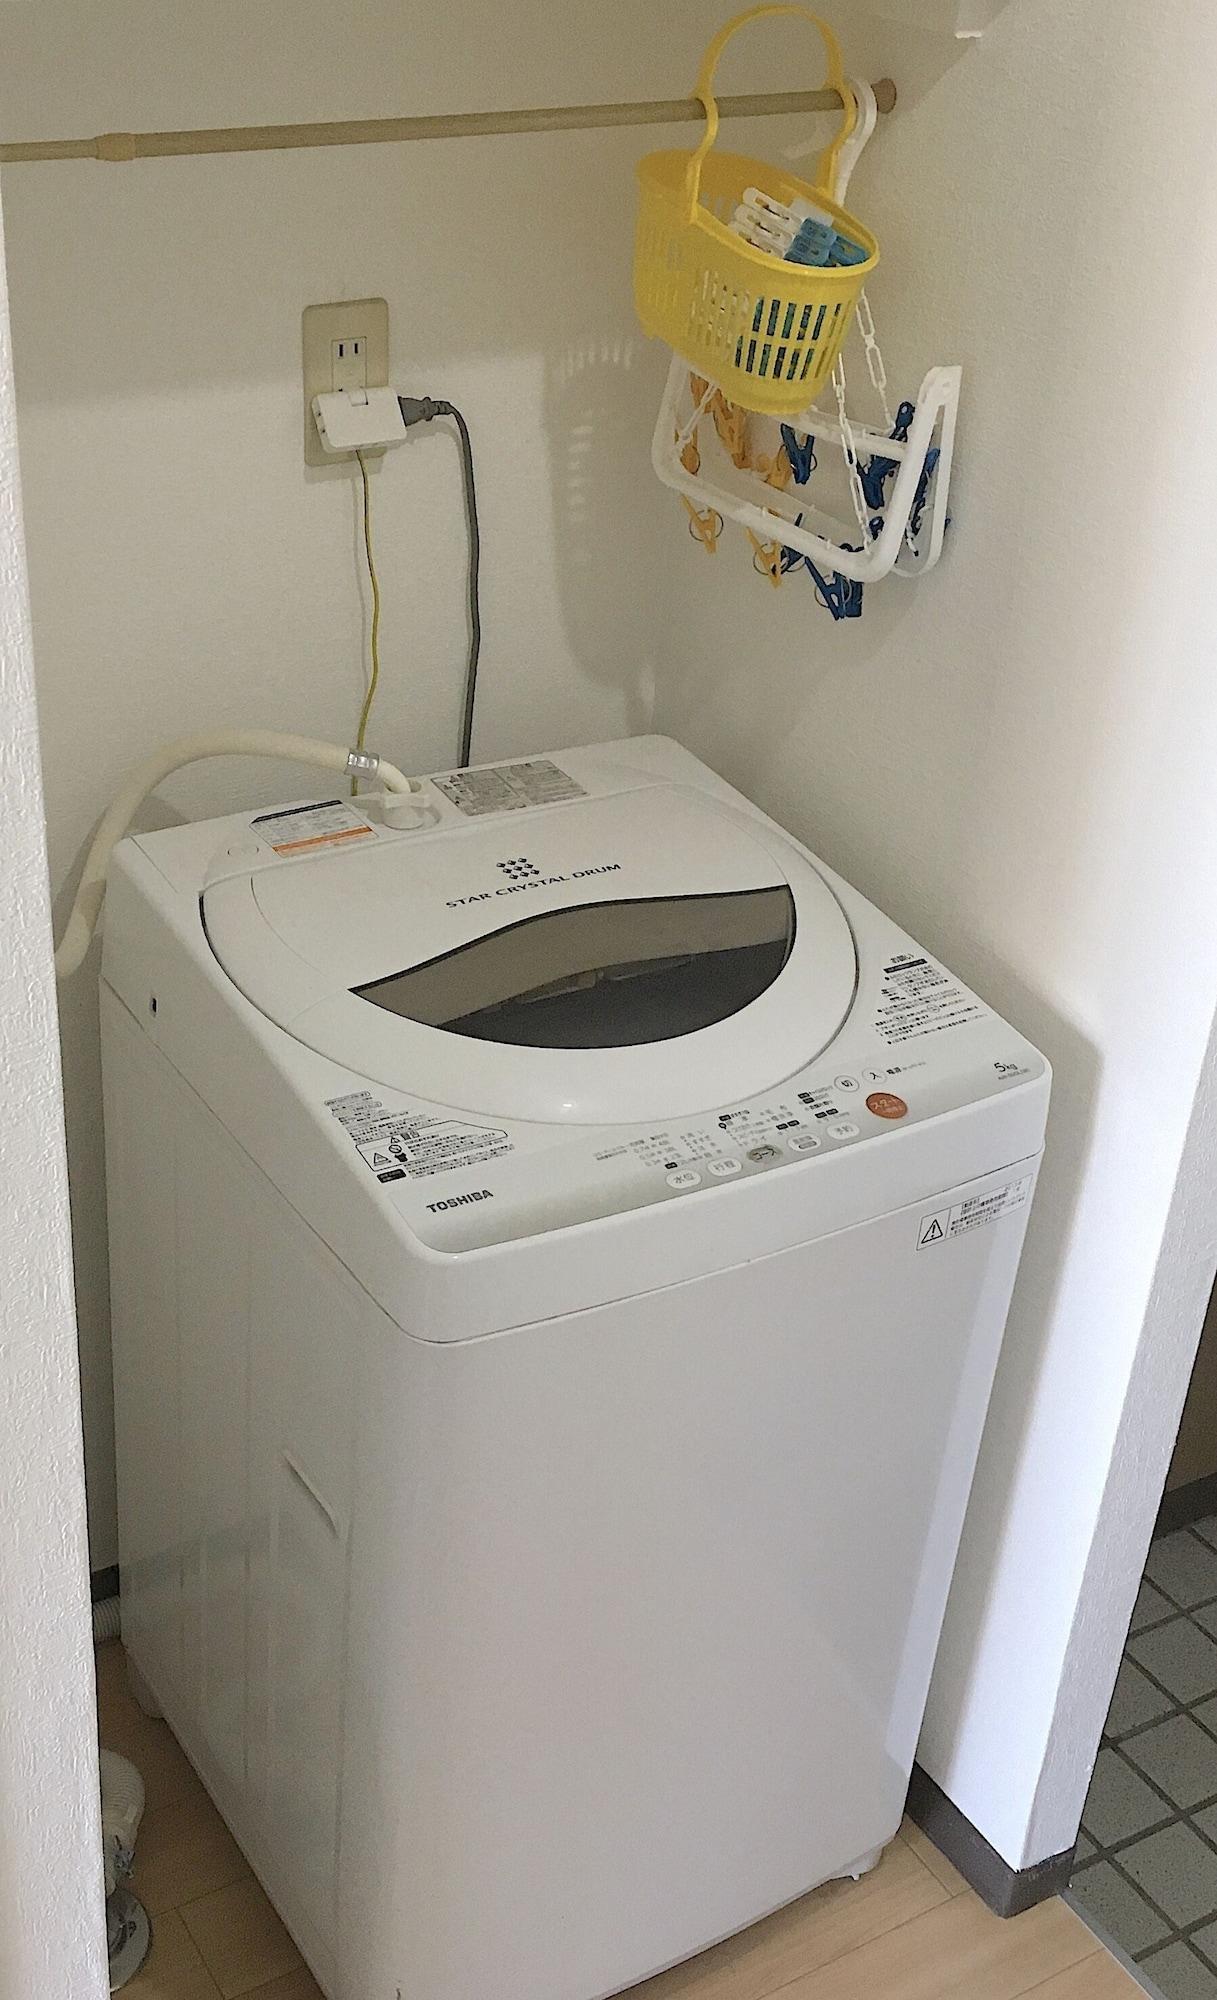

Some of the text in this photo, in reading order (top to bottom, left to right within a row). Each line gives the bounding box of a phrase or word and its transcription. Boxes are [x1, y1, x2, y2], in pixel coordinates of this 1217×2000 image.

[446, 863, 621, 908] STAR CRYSTAL DRUM
[994, 1062, 1018, 1072] 5kg
[425, 1189, 494, 1213] TOSHIBA
